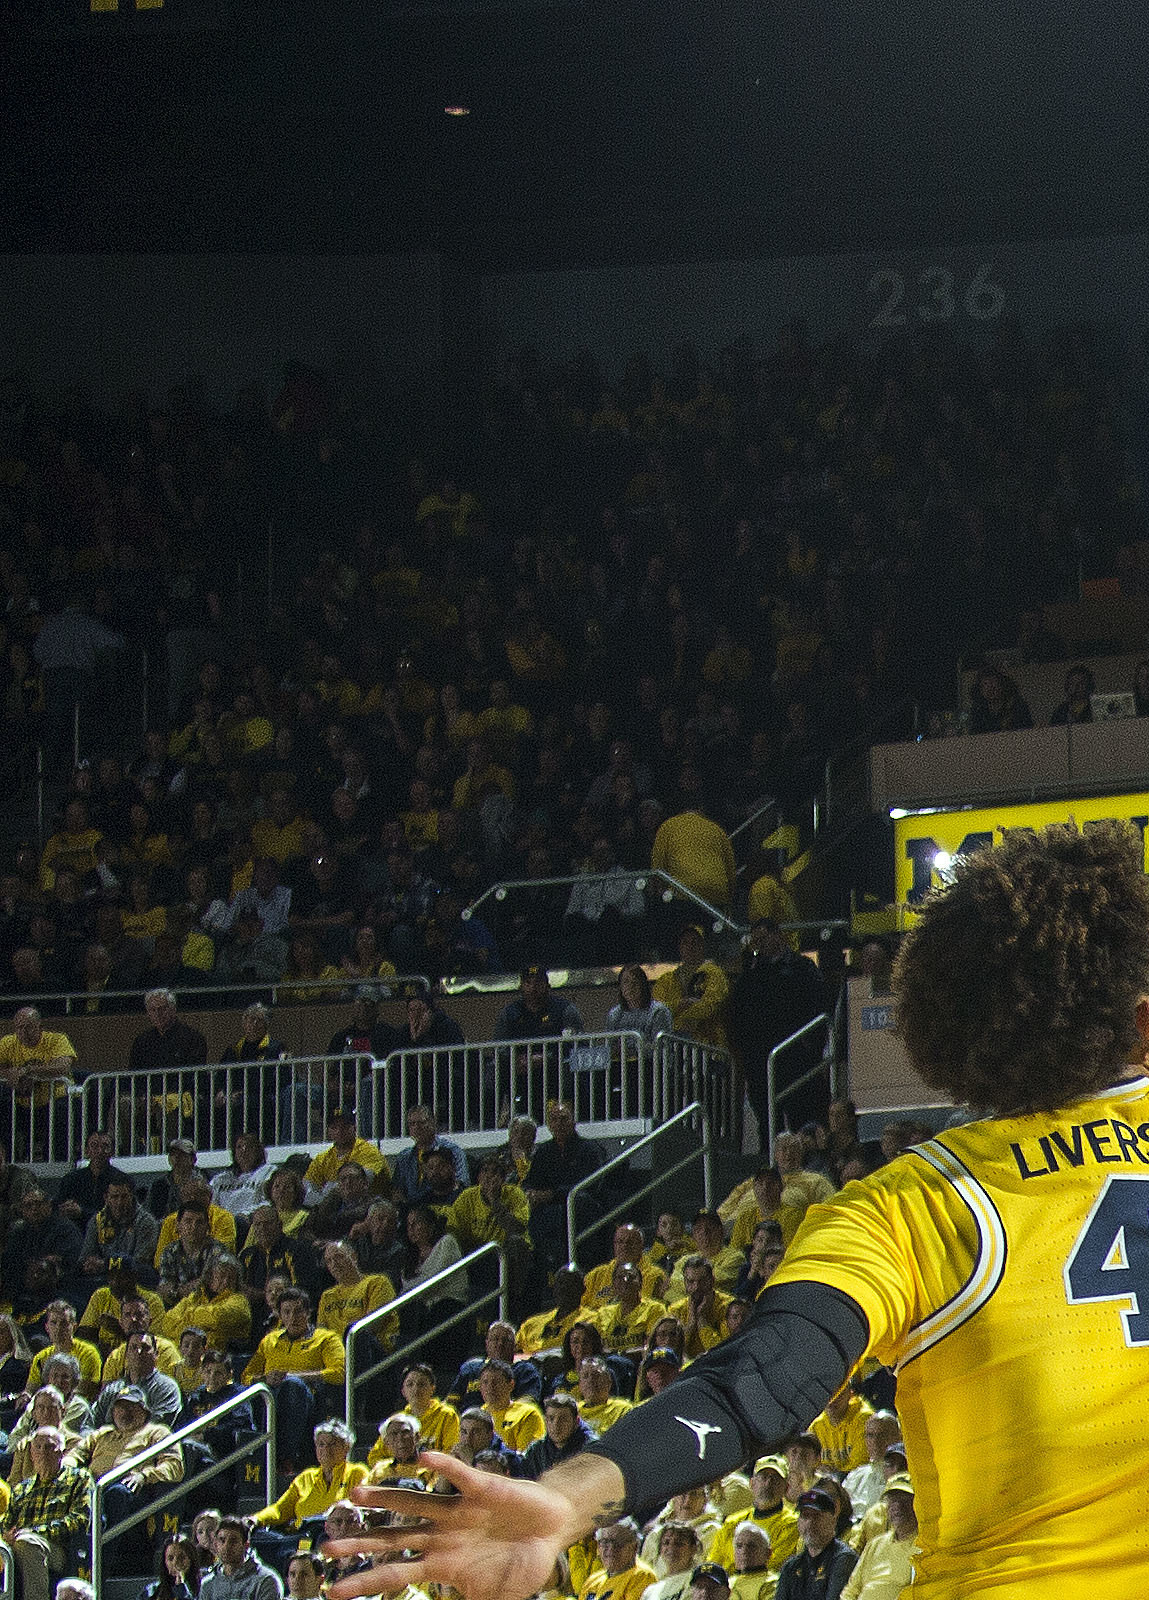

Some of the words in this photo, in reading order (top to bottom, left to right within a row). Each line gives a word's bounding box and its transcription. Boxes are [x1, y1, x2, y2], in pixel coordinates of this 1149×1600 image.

[868, 262, 1006, 326] 236
[245, 1463, 260, 1483] M
[163, 1513, 179, 1533] M
